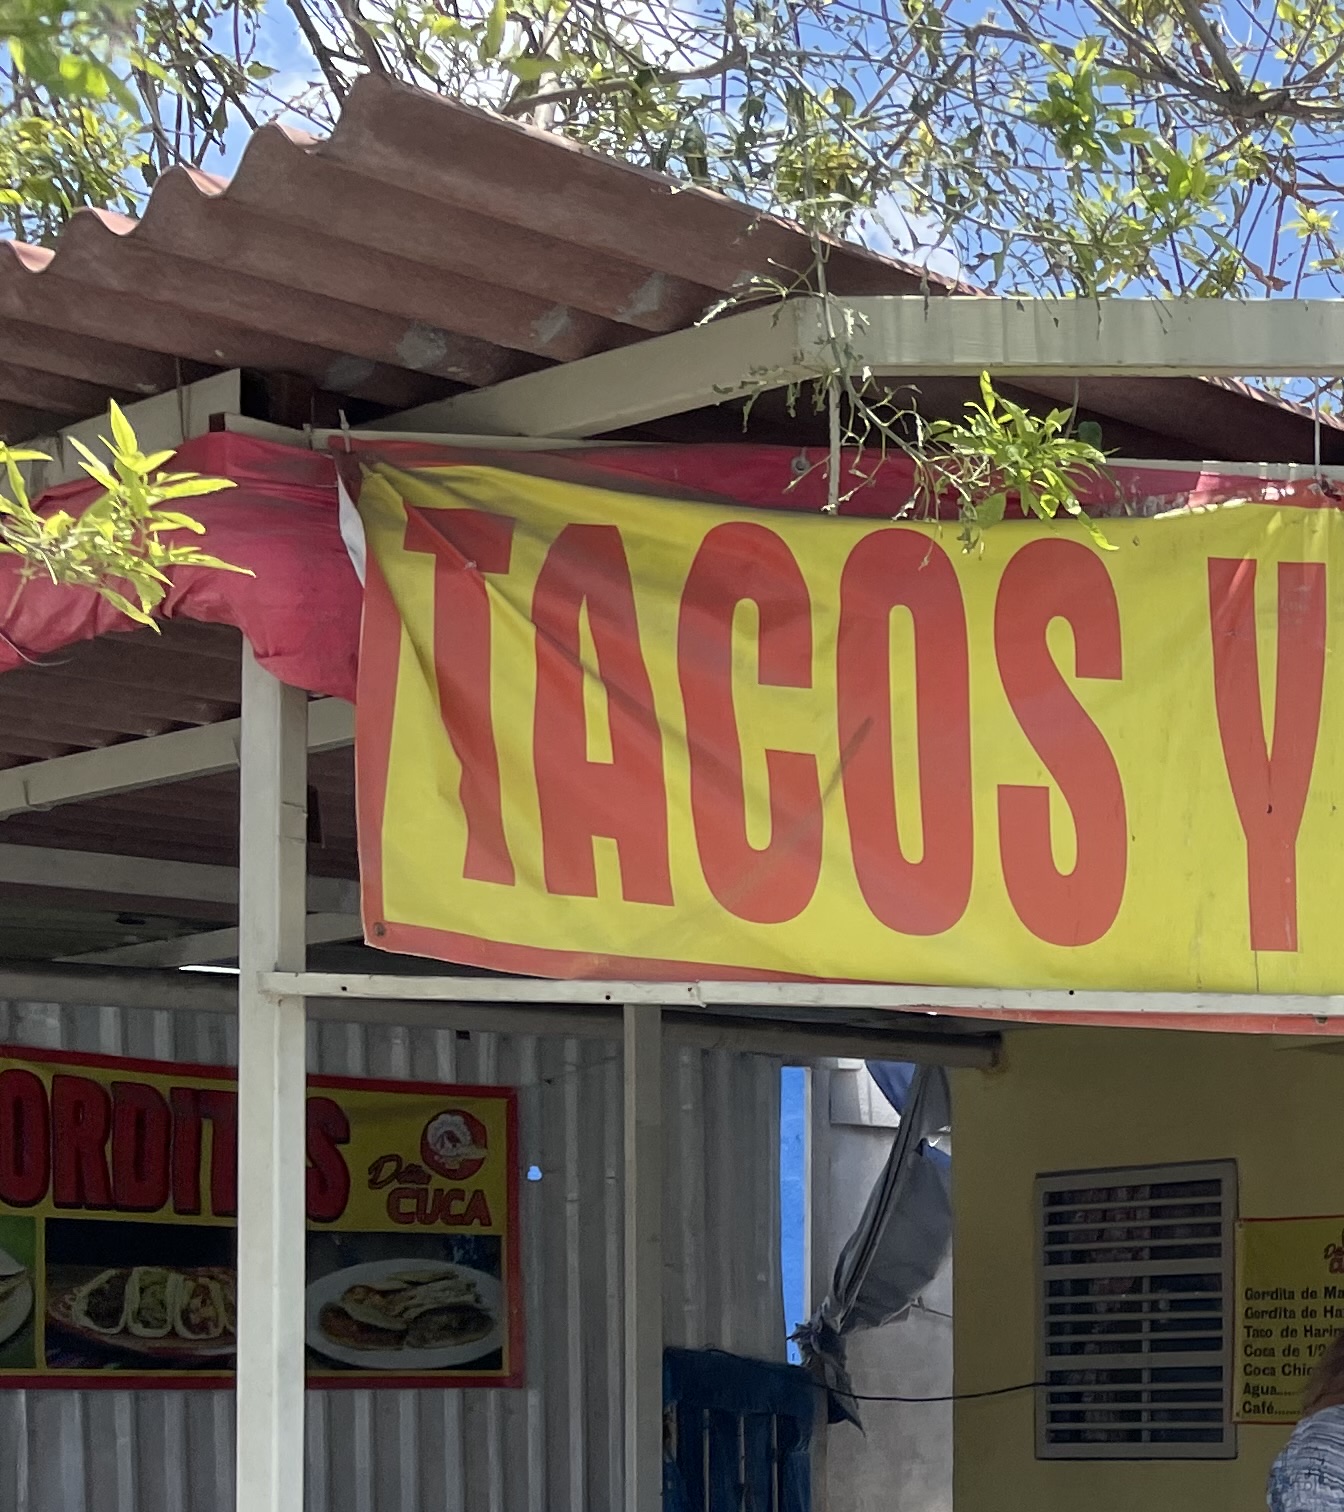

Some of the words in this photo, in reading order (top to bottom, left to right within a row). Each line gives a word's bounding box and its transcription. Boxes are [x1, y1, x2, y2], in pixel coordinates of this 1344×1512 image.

[403, 506, 1127, 948] TACOS
[1207, 556, 1327, 952] Y
[0, 1068, 351, 1223] ORDITS
[387, 1187, 492, 1226] CUCA
[1245, 1287, 1295, 1301] Gordita
[1301, 1285, 1318, 1299] de
[1245, 1306, 1296, 1320] Gordita
[1301, 1305, 1317, 1319] de
[1244, 1325, 1273, 1339] Taco
[1280, 1324, 1298, 1338] de
[1282, 1344, 1300, 1357] de
[1243, 1363, 1276, 1377] Coca
